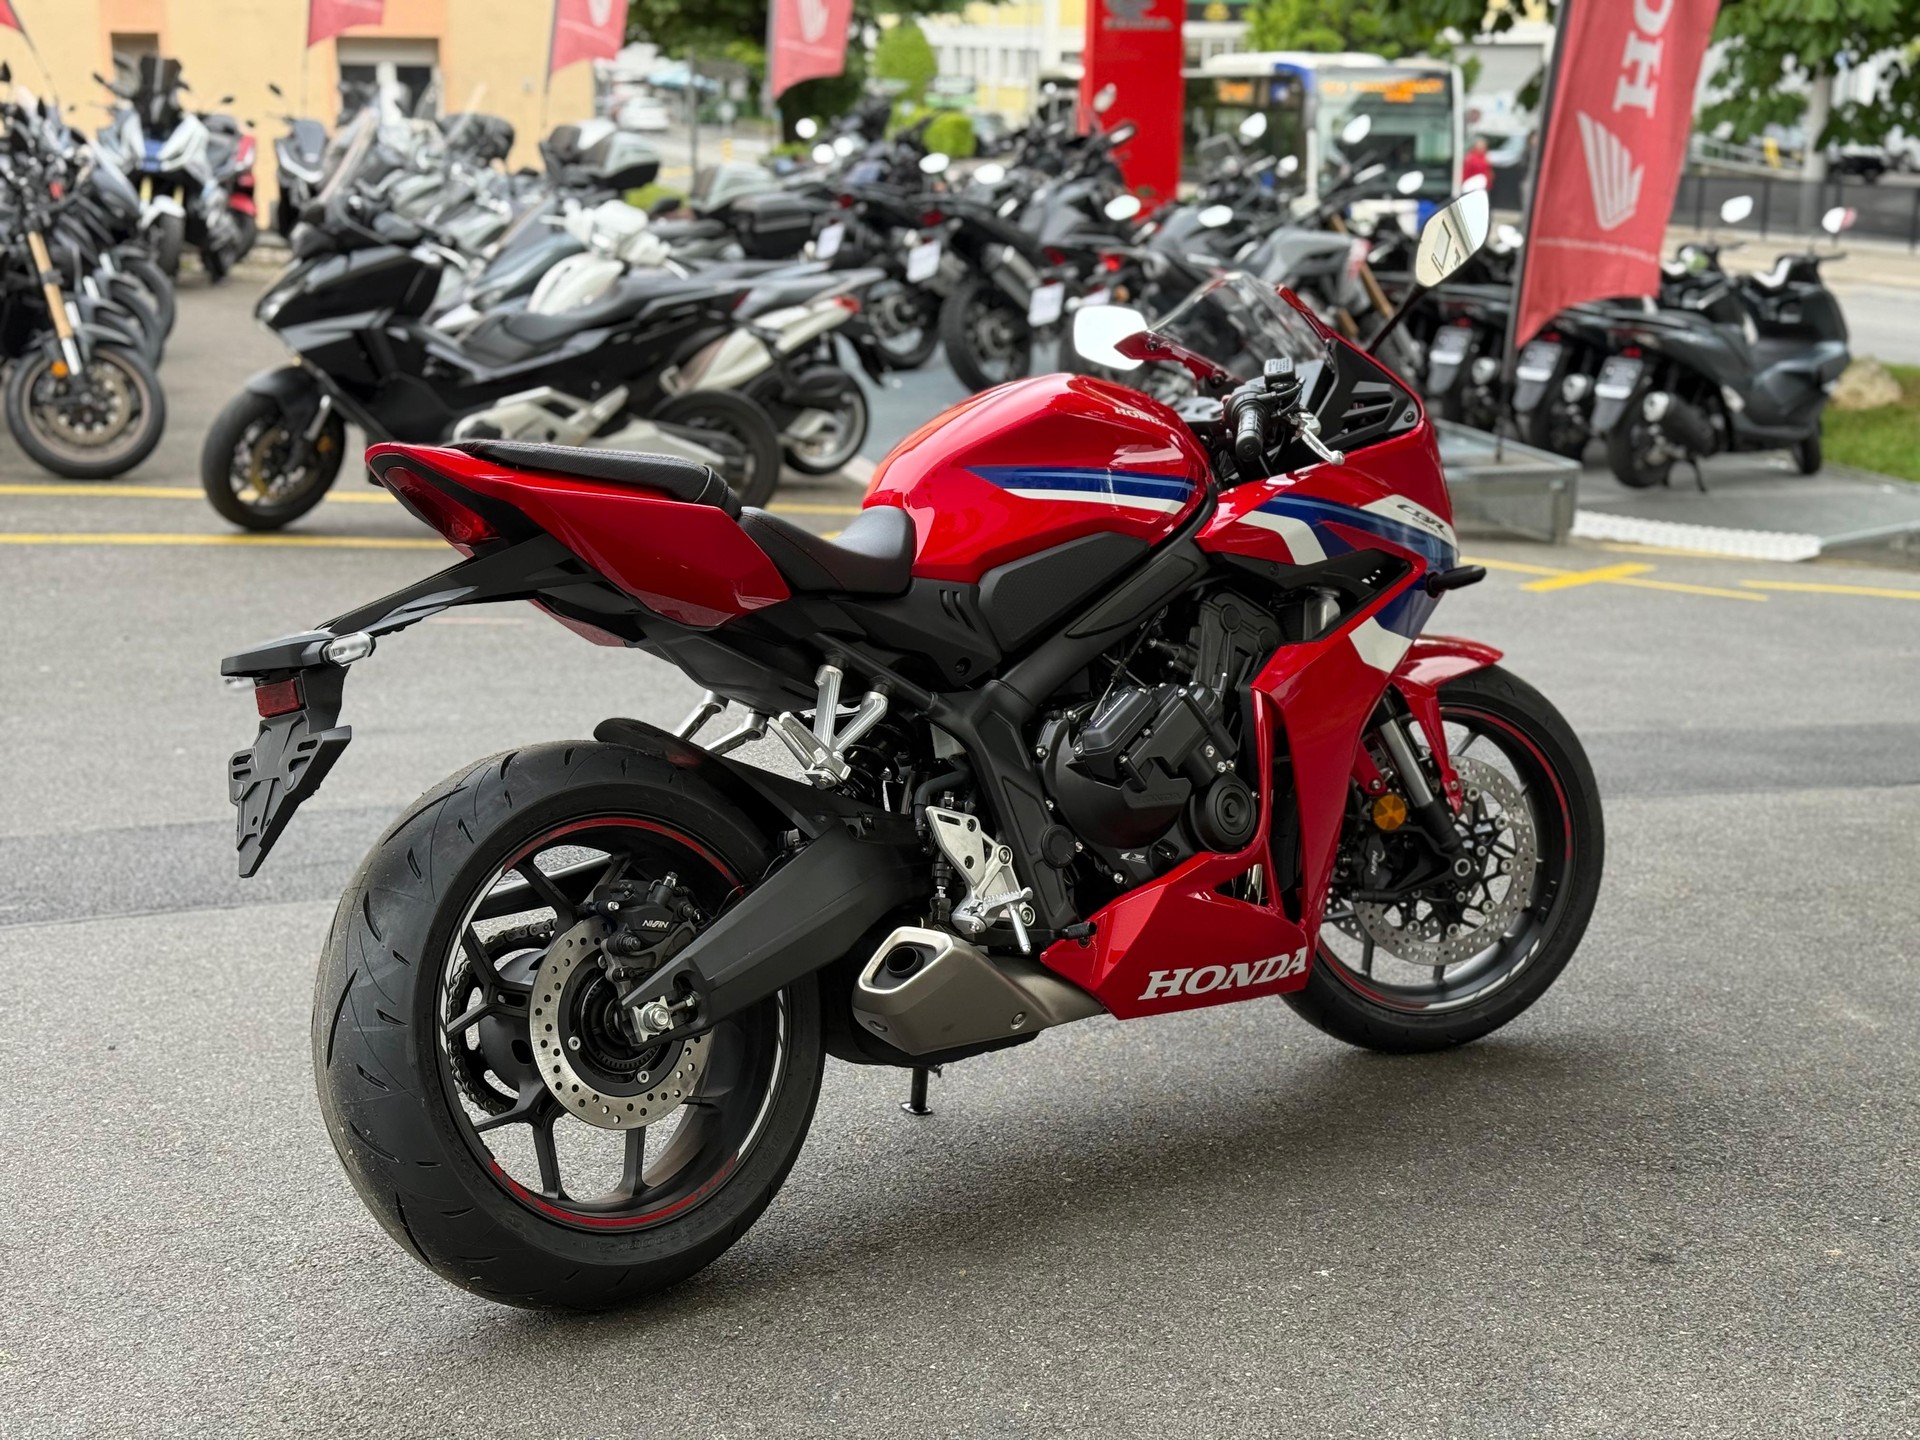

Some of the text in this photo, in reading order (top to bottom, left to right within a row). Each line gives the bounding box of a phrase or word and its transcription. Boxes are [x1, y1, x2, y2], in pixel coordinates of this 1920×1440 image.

[1396, 503, 1446, 536] CBR
[642, 919, 670, 929] NISSIN
[1137, 946, 1308, 1000] HONDA
